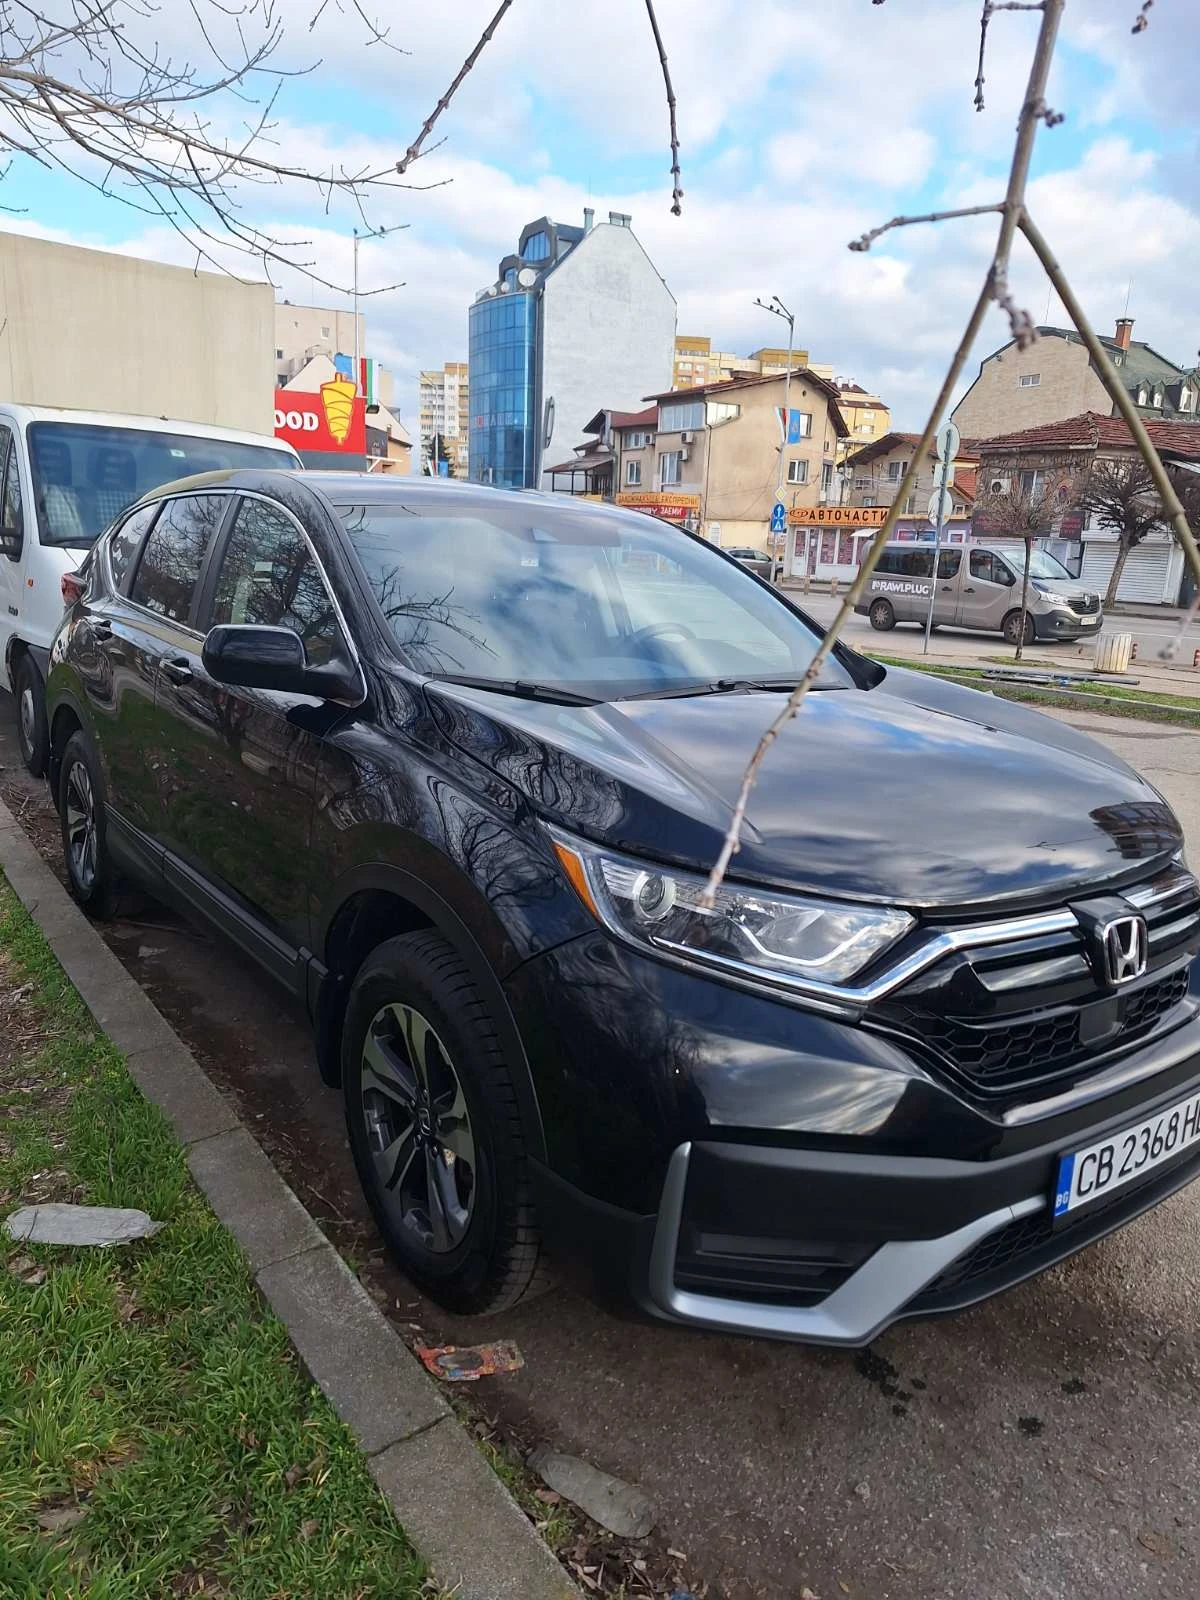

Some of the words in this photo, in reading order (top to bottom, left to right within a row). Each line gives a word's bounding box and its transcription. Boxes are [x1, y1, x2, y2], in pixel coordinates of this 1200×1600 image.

[274, 409, 319, 431] OOD
[809, 510, 888, 521] АВТОЧАСТИ
[1077, 1144, 1115, 1197] CB
[1118, 1112, 1180, 1178] 2368
[1055, 1191, 1069, 1208] BG
